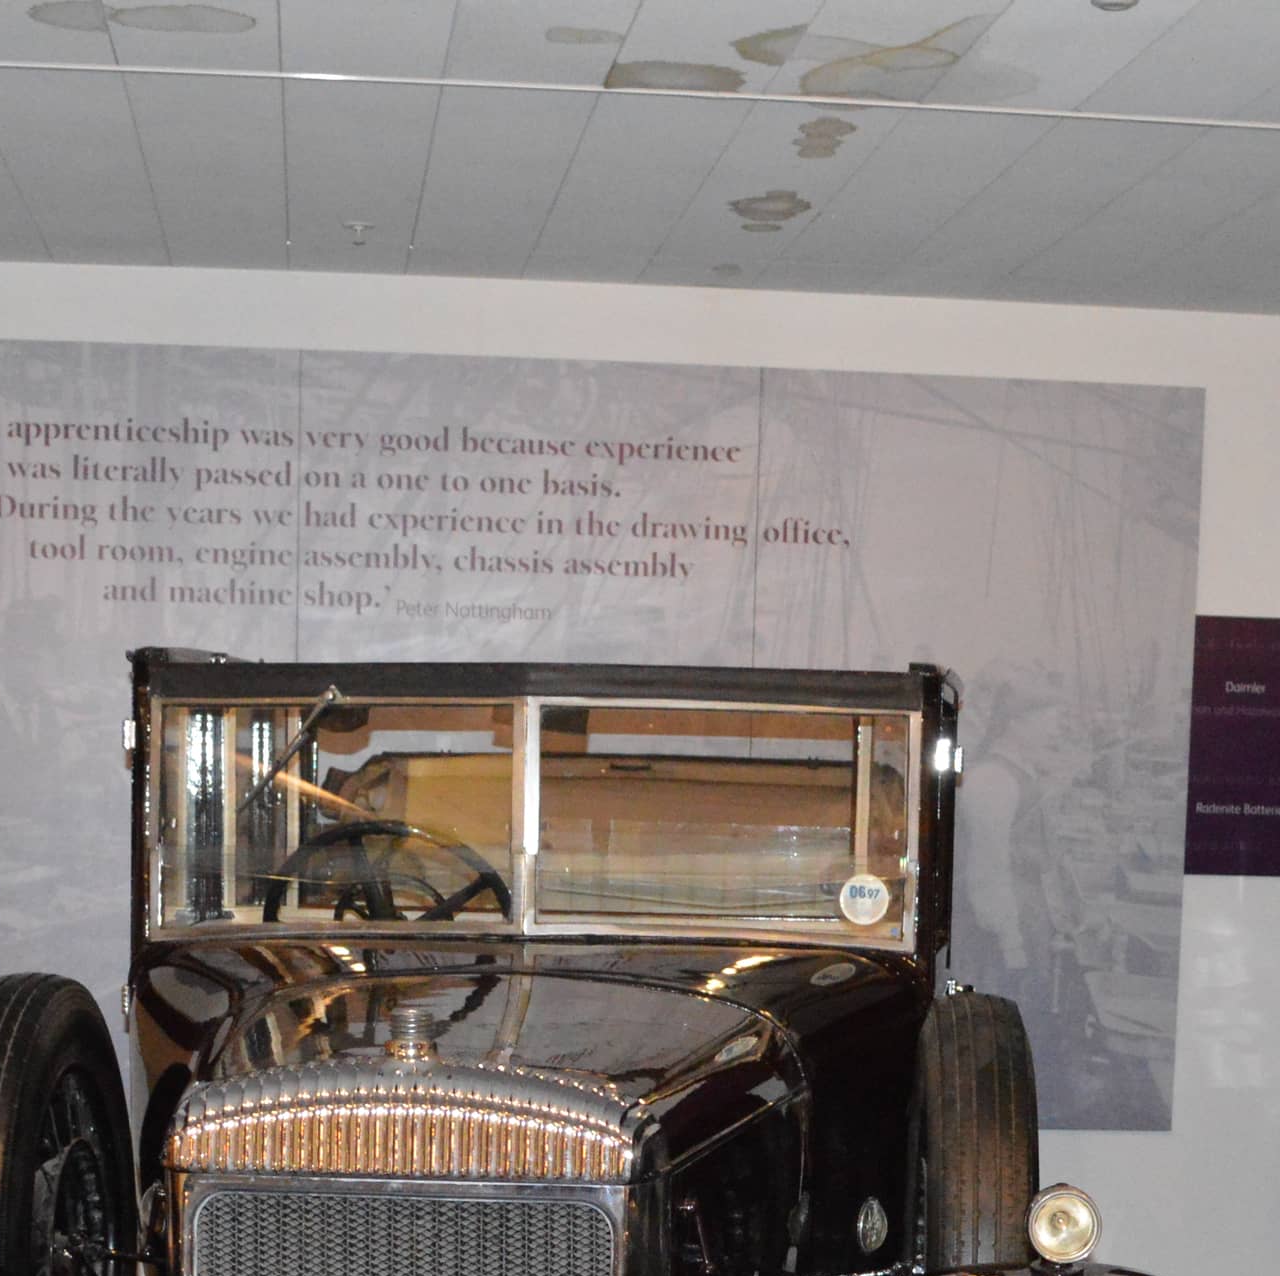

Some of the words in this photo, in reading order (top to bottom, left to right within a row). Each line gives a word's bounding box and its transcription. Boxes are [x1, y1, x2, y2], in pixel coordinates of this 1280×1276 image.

[7, 414, 230, 451] apprenticeship
[240, 428, 295, 448] was
[304, 430, 369, 452] very
[378, 425, 450, 455] good
[461, 426, 577, 458] because
[585, 435, 742, 465] experience
[7, 460, 62, 481] was
[72, 454, 182, 485] literally
[194, 461, 294, 491] passed
[304, 470, 342, 490] on
[349, 469, 368, 490] a
[377, 472, 429, 493] one
[440, 470, 470, 492] to
[479, 475, 533, 497] one
[542, 468, 622, 499] basis.
[109, 495, 157, 524] the
[166, 505, 243, 530] years
[251, 507, 294, 528] we
[304, 501, 358, 530] had
[366, 509, 527, 538] experience
[536, 509, 565, 537] in
[574, 510, 621, 538] the
[630, 512, 750, 547] drawing
[762, 517, 852, 550] office,
[28, 533, 86, 562] tool
[96, 542, 185, 568] room,
[194, 541, 295, 570] engine
[303, 543, 444, 574] assembly,
[453, 546, 555, 576] chassis
[562, 551, 695, 581] assembly
[102, 576, 158, 604] and
[168, 580, 295, 608] machine
[395, 598, 441, 619] Peter
[1225, 680, 1267, 696] Daimler
